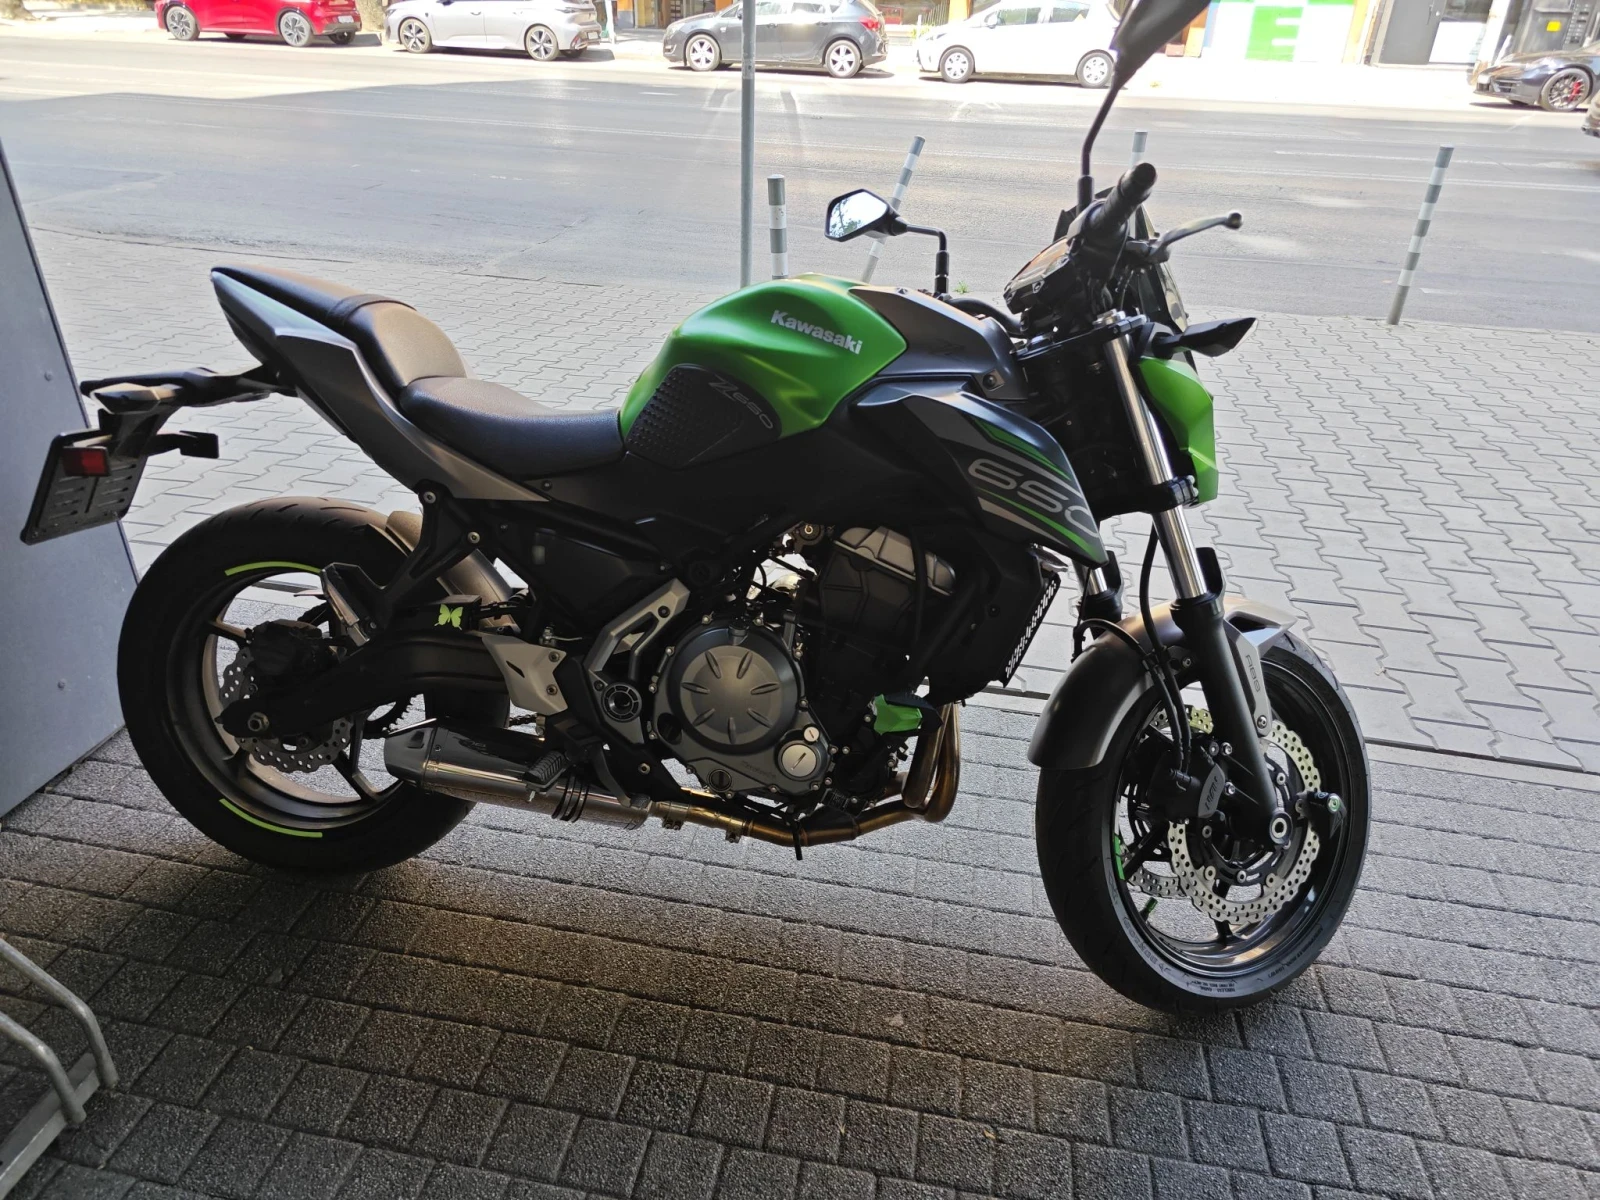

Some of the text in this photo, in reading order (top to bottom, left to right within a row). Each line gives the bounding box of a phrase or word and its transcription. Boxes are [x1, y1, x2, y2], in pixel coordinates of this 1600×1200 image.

[770, 310, 863, 355] Kawasaki
[709, 373, 774, 429] Z650
[967, 458, 1100, 538] 650
